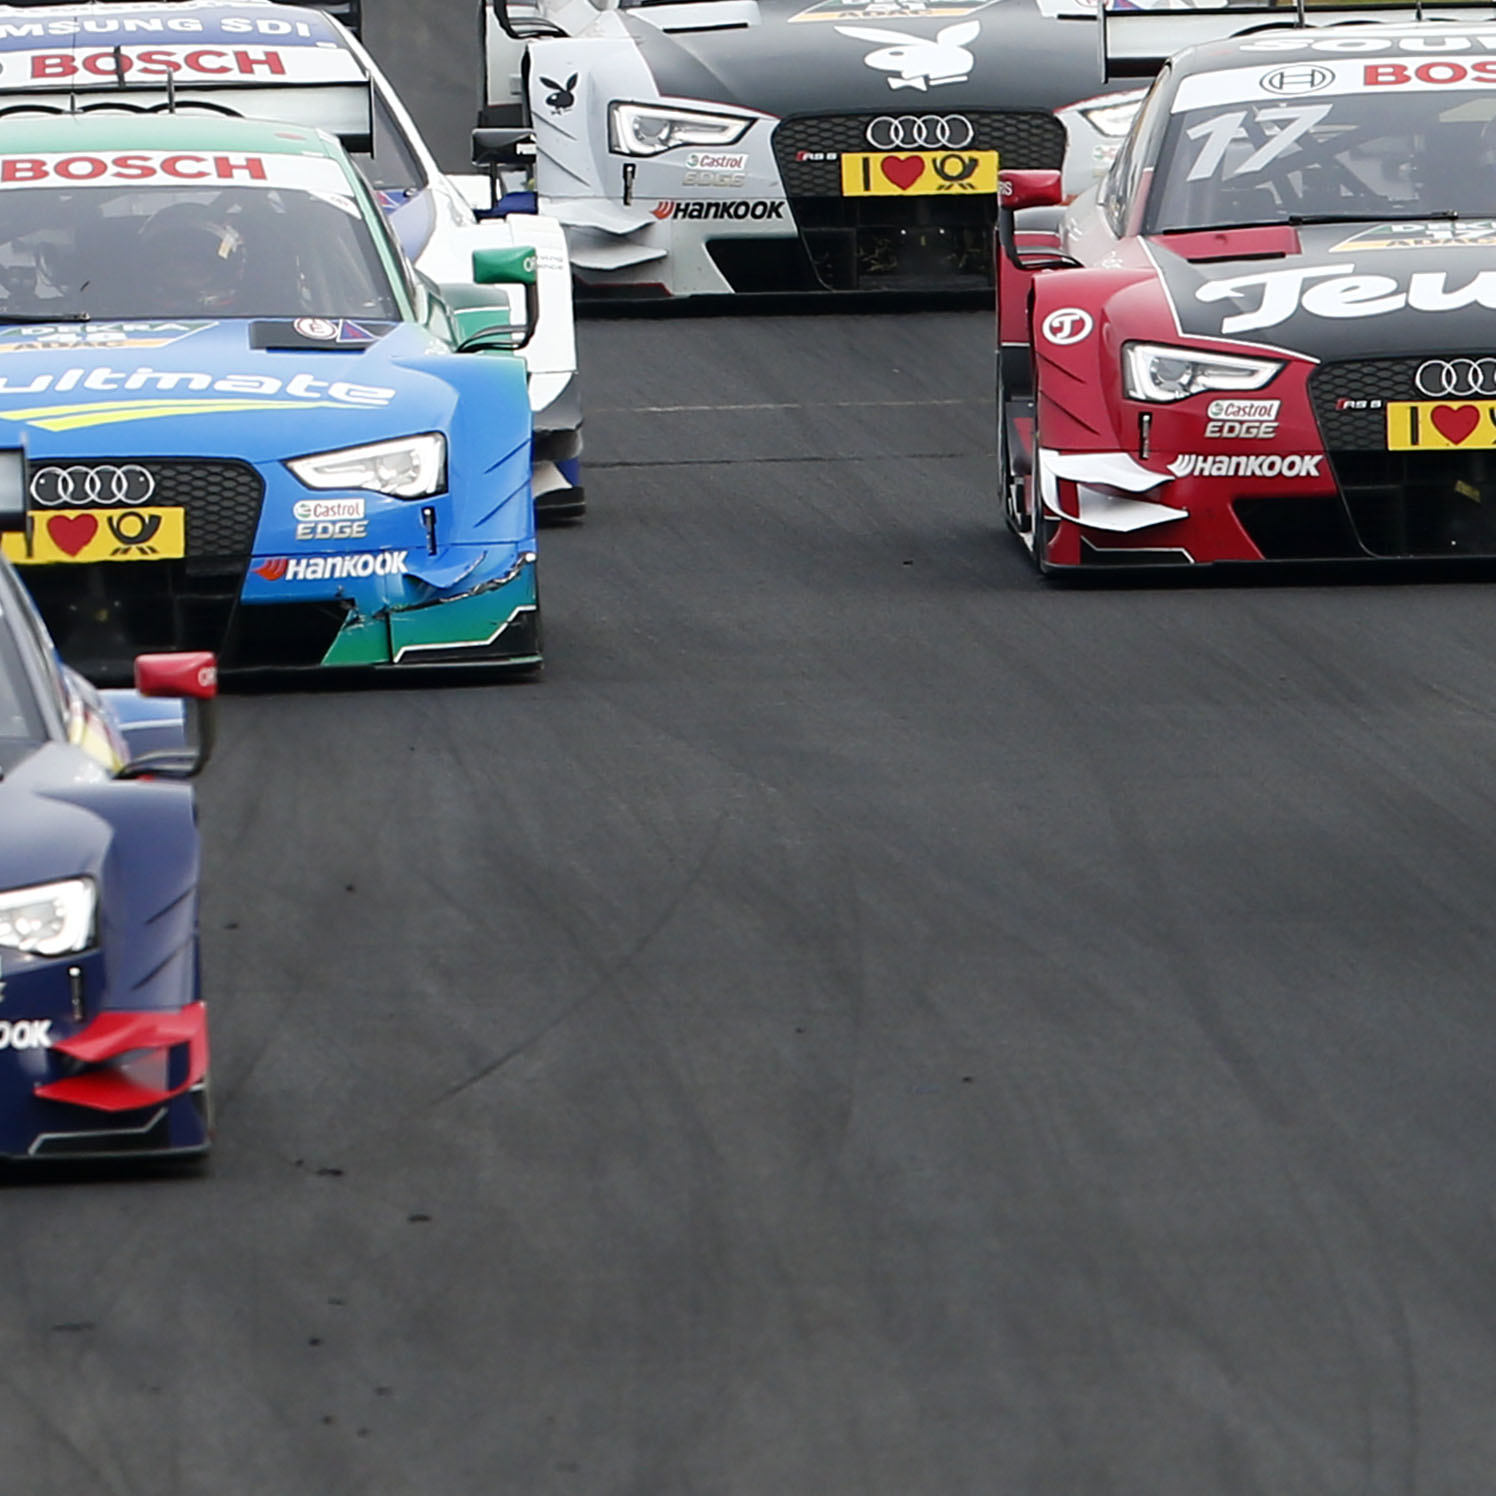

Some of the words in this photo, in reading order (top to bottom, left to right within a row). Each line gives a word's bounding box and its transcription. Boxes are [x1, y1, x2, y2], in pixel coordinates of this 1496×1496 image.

[219, 16, 313, 38] SDI
[29, 49, 288, 80] BOSCH
[1184, 102, 1336, 183] 17
[0, 155, 269, 183] BOSCH
[699, 154, 744, 170] Castrol
[682, 171, 747, 188] EDGE
[861, 156, 871, 193] I
[1224, 402, 1275, 421] Castrol
[1204, 422, 1279, 440] EDGE
[1410, 406, 1420, 446] I
[312, 501, 362, 519] Castrol
[295, 521, 369, 540] EDGE
